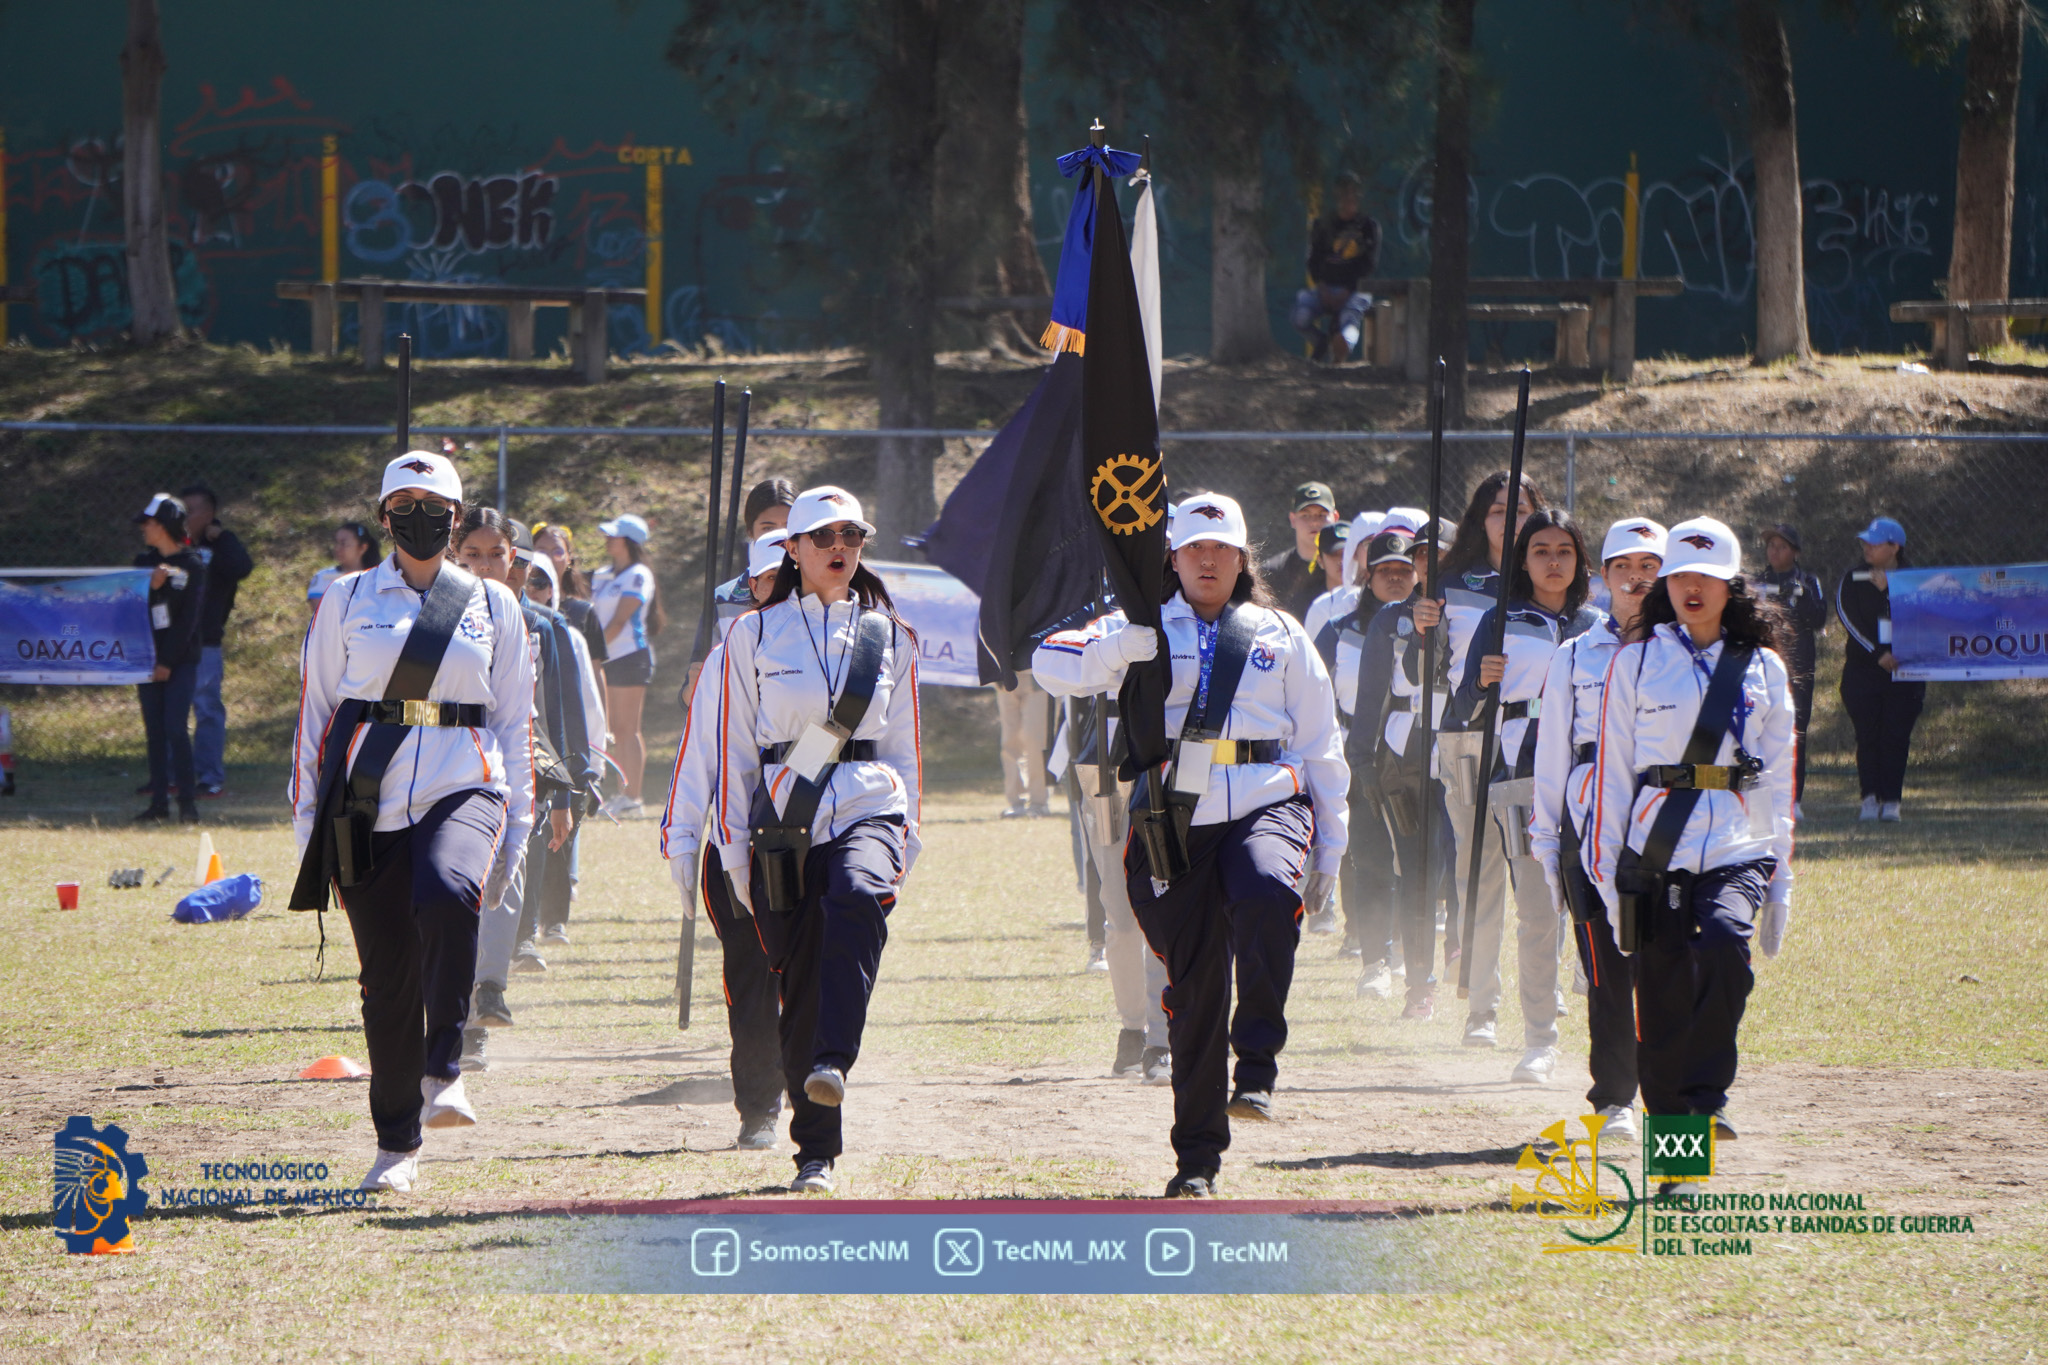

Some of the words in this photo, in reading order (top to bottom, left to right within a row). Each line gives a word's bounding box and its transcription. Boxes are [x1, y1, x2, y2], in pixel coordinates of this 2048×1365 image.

[617, 145, 693, 166] CORTA
[17, 639, 125, 660] OAXACA
[926, 641, 954, 659] LA
[1949, 634, 2048, 659] ROQU
